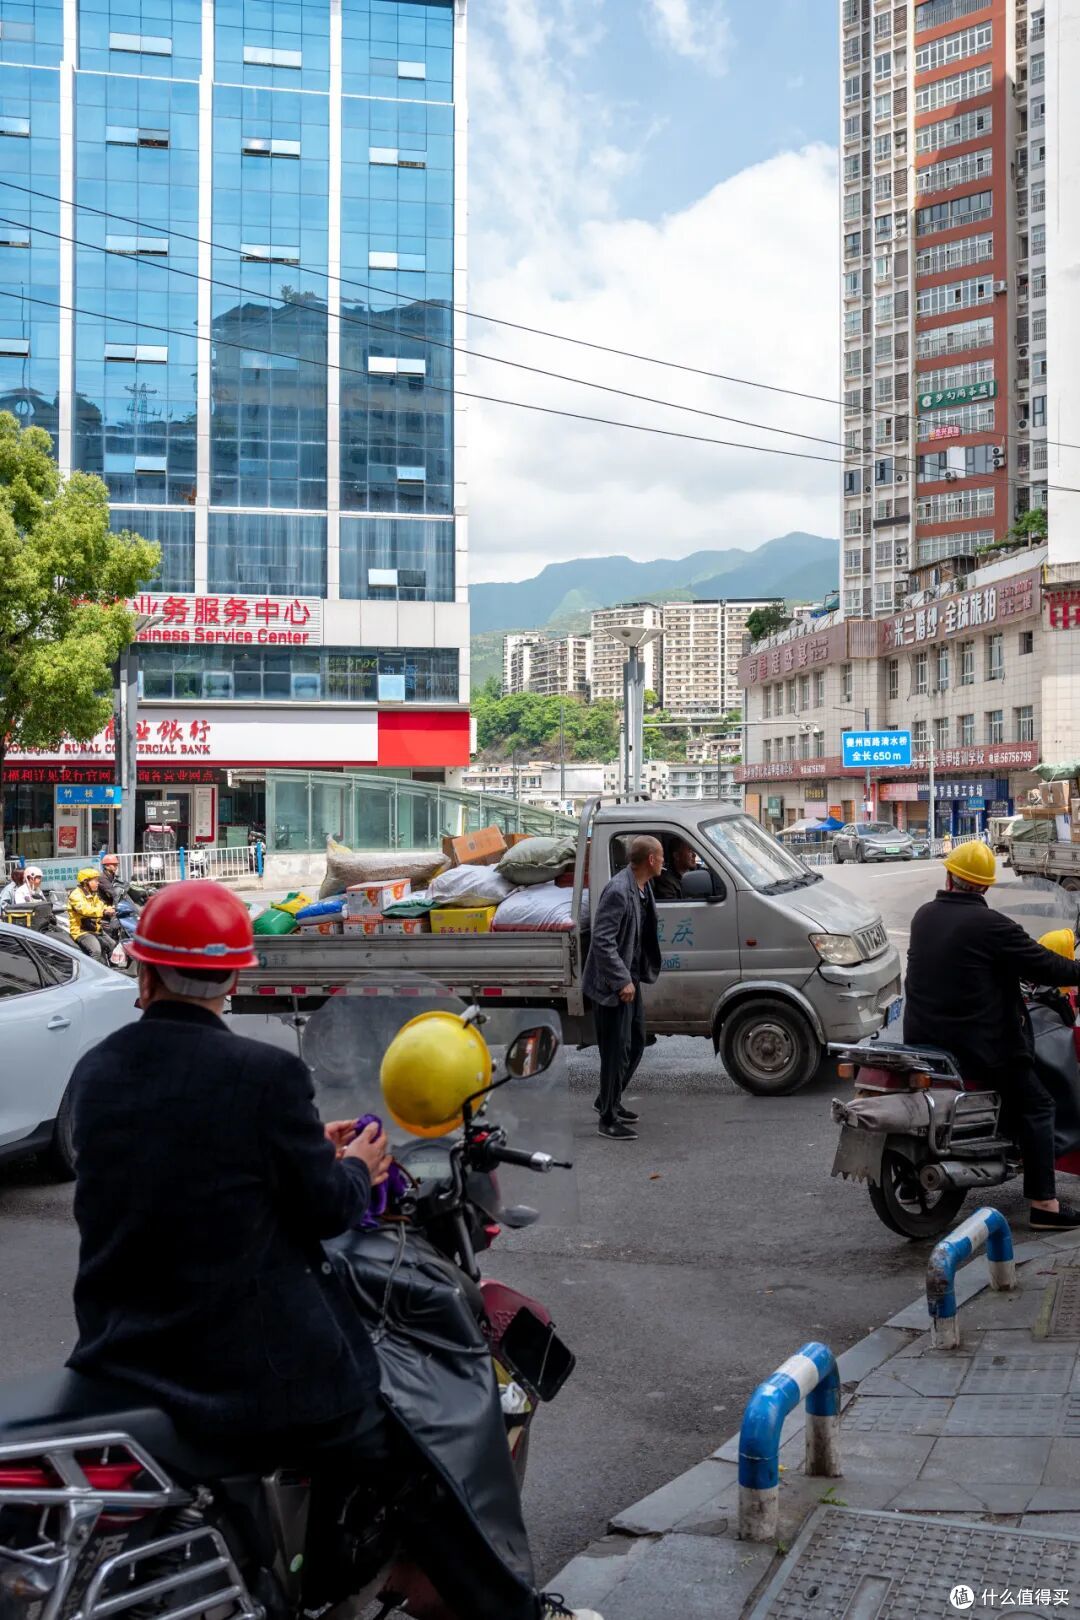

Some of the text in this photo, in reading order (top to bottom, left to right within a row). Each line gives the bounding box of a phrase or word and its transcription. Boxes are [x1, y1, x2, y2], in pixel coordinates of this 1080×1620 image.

[194, 627, 252, 643] Service
[257, 628, 309, 644] Center
[64, 743, 102, 755] RURAL
[105, 743, 177, 755] COERCIAL
[180, 744, 211, 755] BANK
[852, 751, 902, 762] 全长 650 m
[64, 788, 115, 799] 竹枝路
